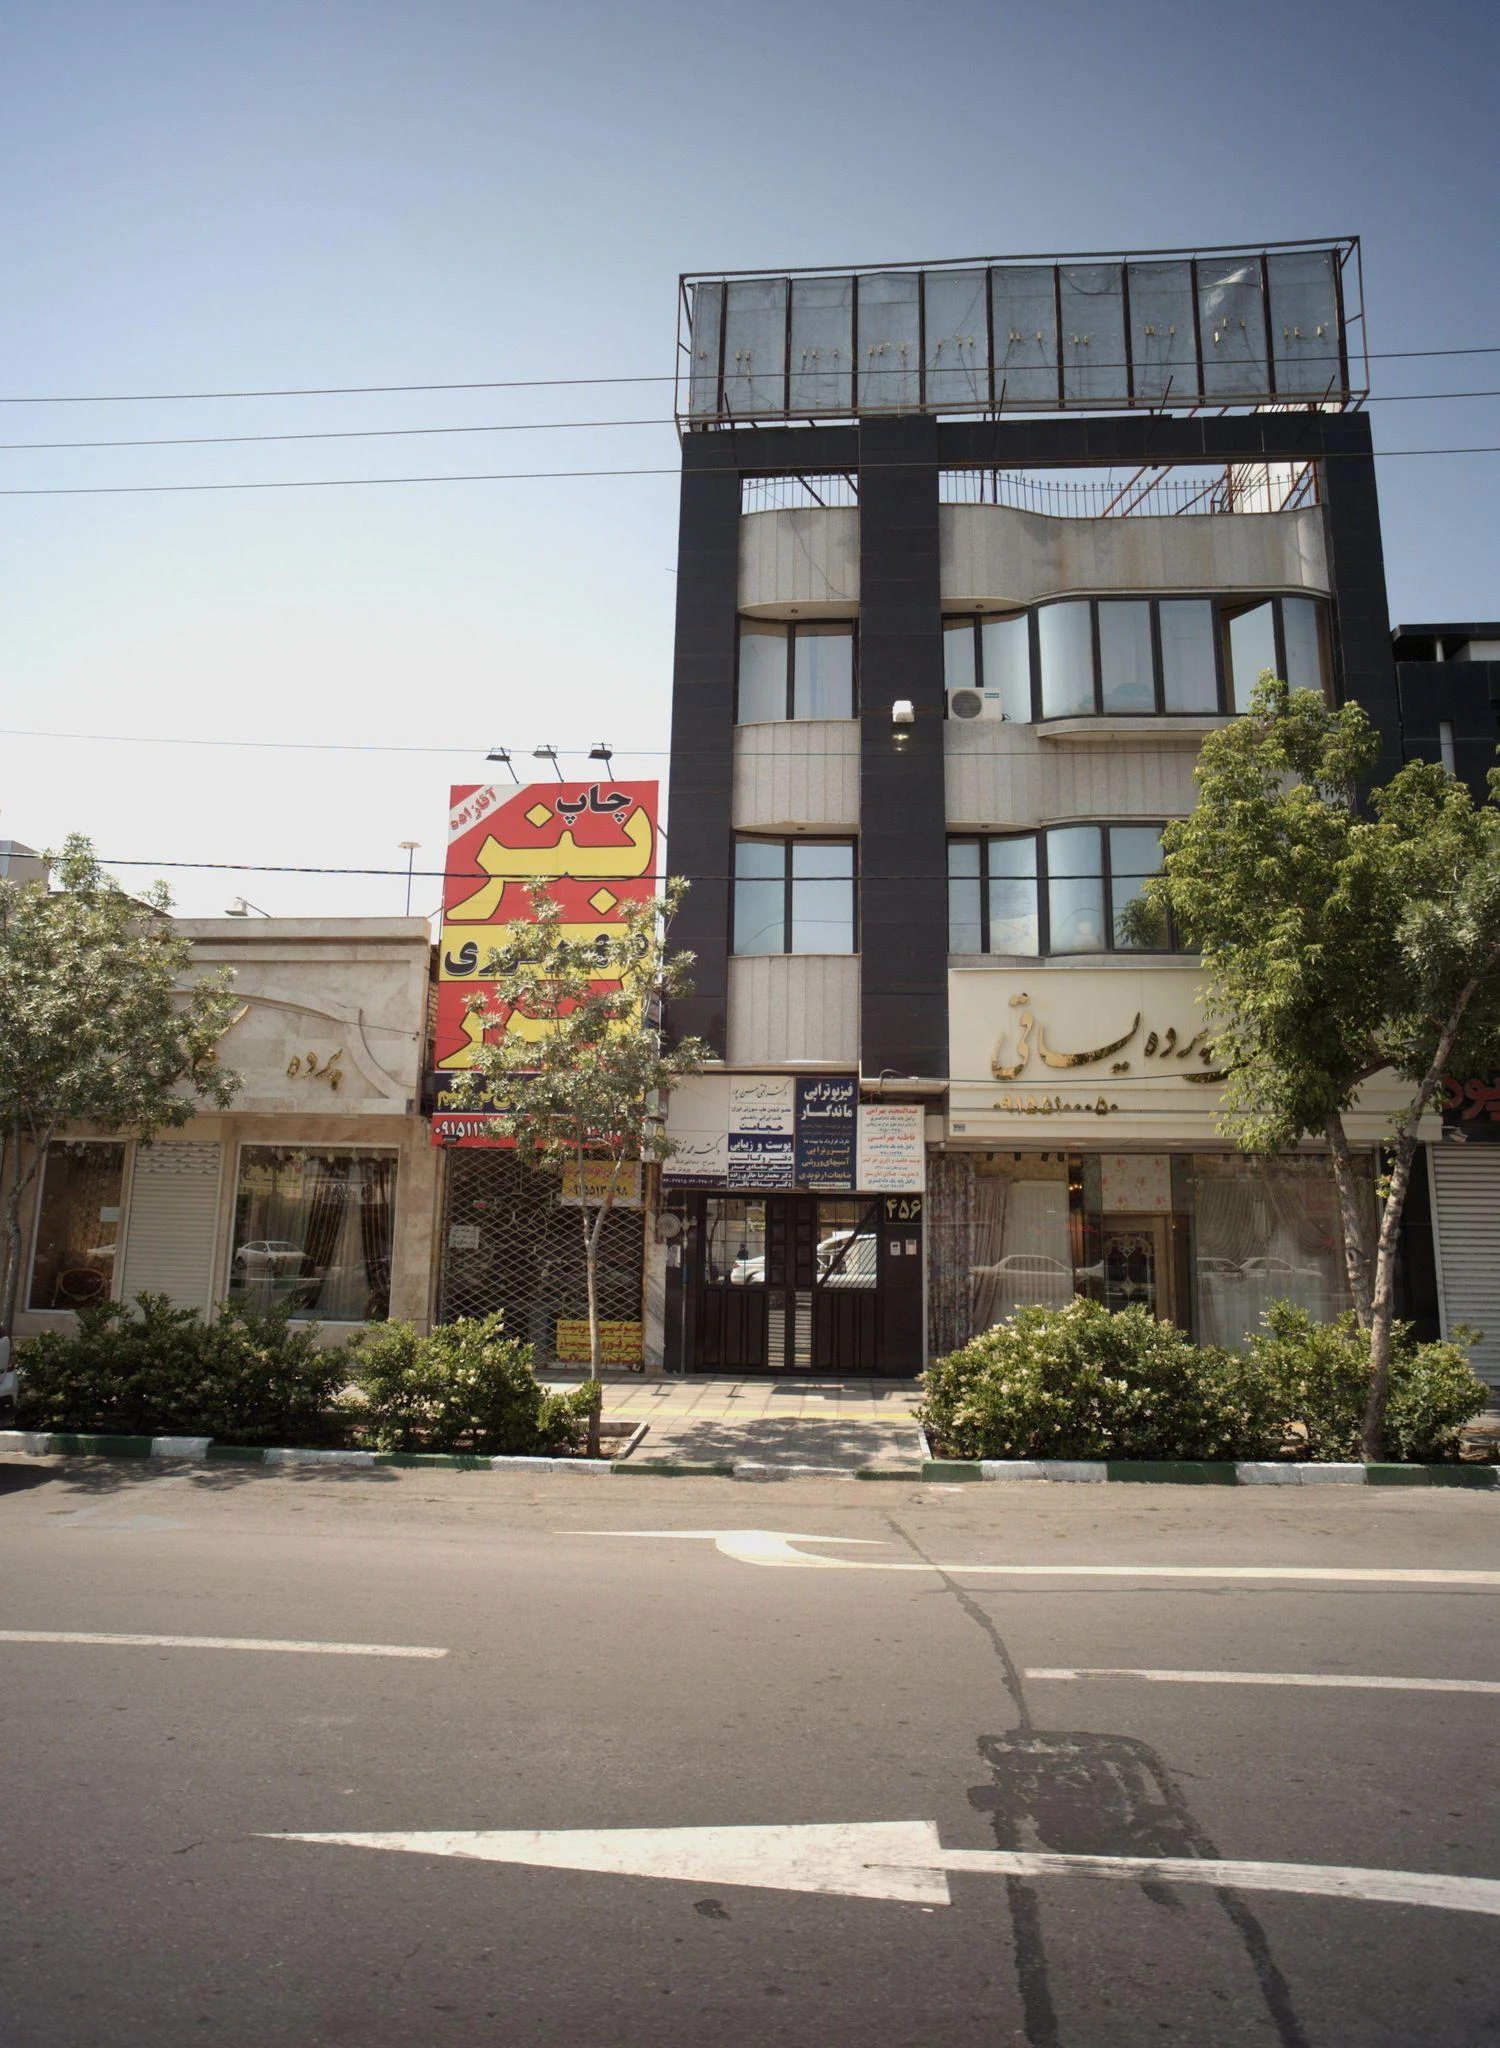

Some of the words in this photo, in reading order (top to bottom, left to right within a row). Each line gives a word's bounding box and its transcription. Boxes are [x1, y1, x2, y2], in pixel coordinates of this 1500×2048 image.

[556, 783, 633, 826] چاپ
[445, 802, 654, 921] بنر
[804, 1082, 853, 1103] فیزیوتراپی
[800, 1104, 853, 1121] ماندگار
[739, 1122, 784, 1134] حجامت
[730, 1138, 754, 1152] زیبایی
[756, 1142, 763, 1152] و
[765, 1140, 792, 1152] پوست
[886, 1198, 922, 1220] ۴۵۶
